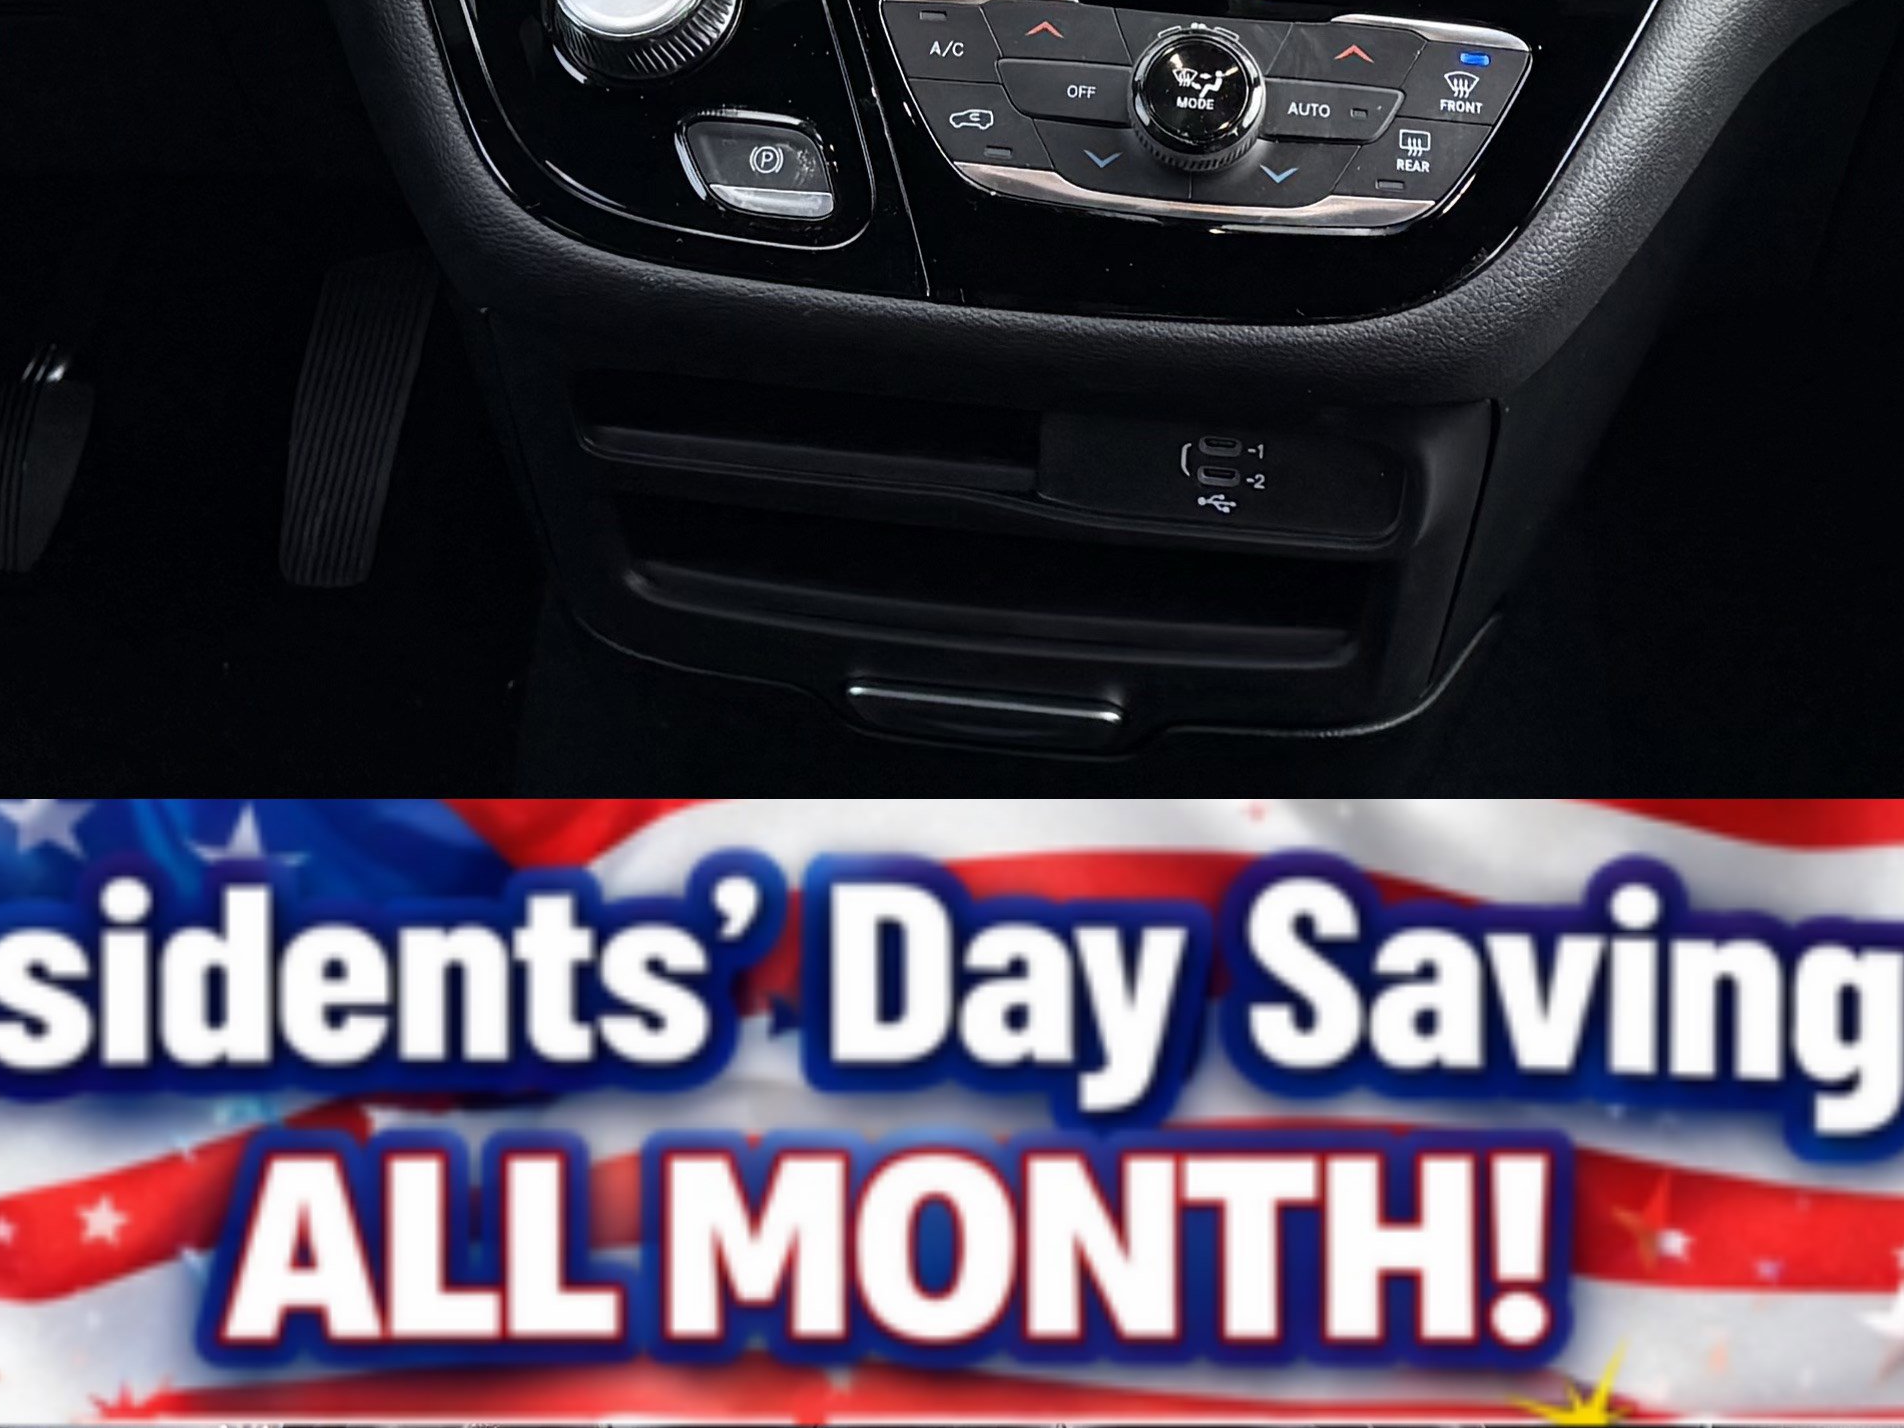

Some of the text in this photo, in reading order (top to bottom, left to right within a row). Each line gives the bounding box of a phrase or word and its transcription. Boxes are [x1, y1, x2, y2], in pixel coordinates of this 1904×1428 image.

[929, 40, 965, 59] A/C
[1066, 83, 1097, 100] OFF
[1175, 96, 1215, 112] MODE
[1286, 101, 1332, 120] AUTO
[1439, 99, 1483, 115] FRONT
[1396, 157, 1431, 174] REAR
